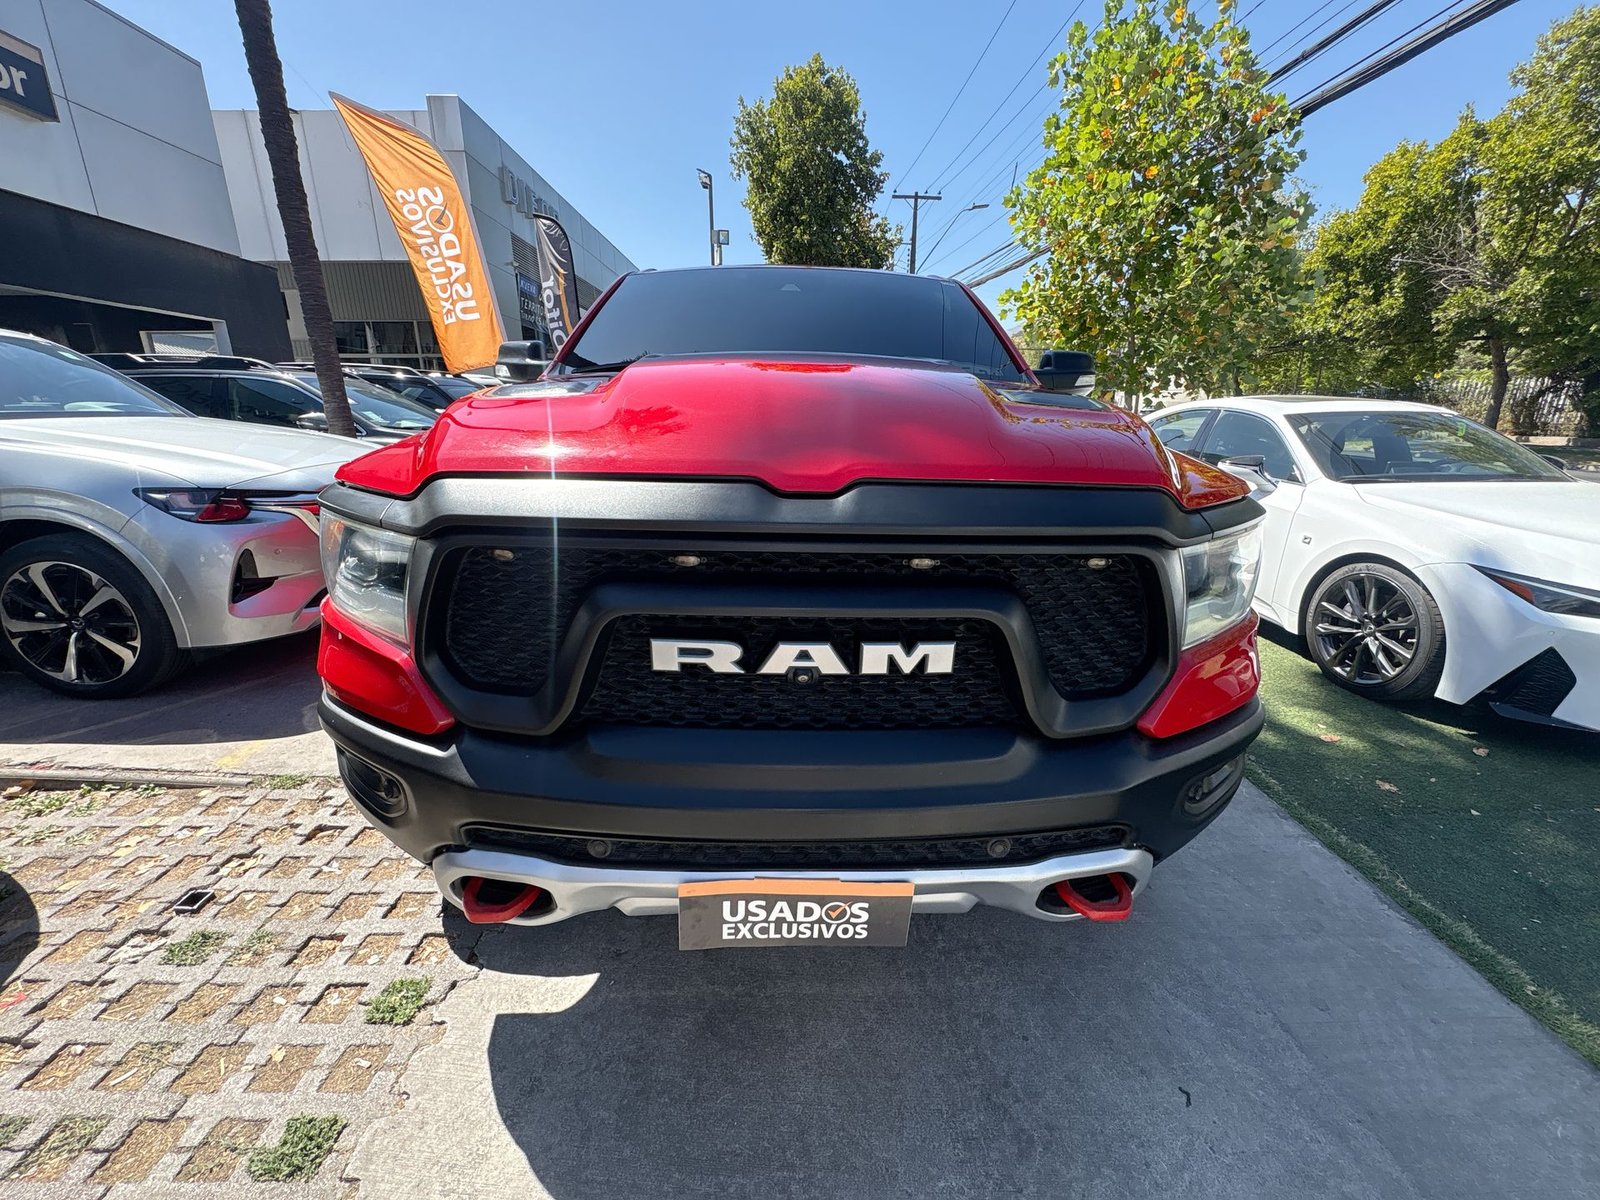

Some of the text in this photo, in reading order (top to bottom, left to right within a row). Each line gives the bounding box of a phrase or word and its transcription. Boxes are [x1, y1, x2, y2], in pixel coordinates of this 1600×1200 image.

[650, 638, 956, 675] RAM
[722, 900, 870, 924] USADOS
[722, 923, 868, 940] EXCLUSIVOS
